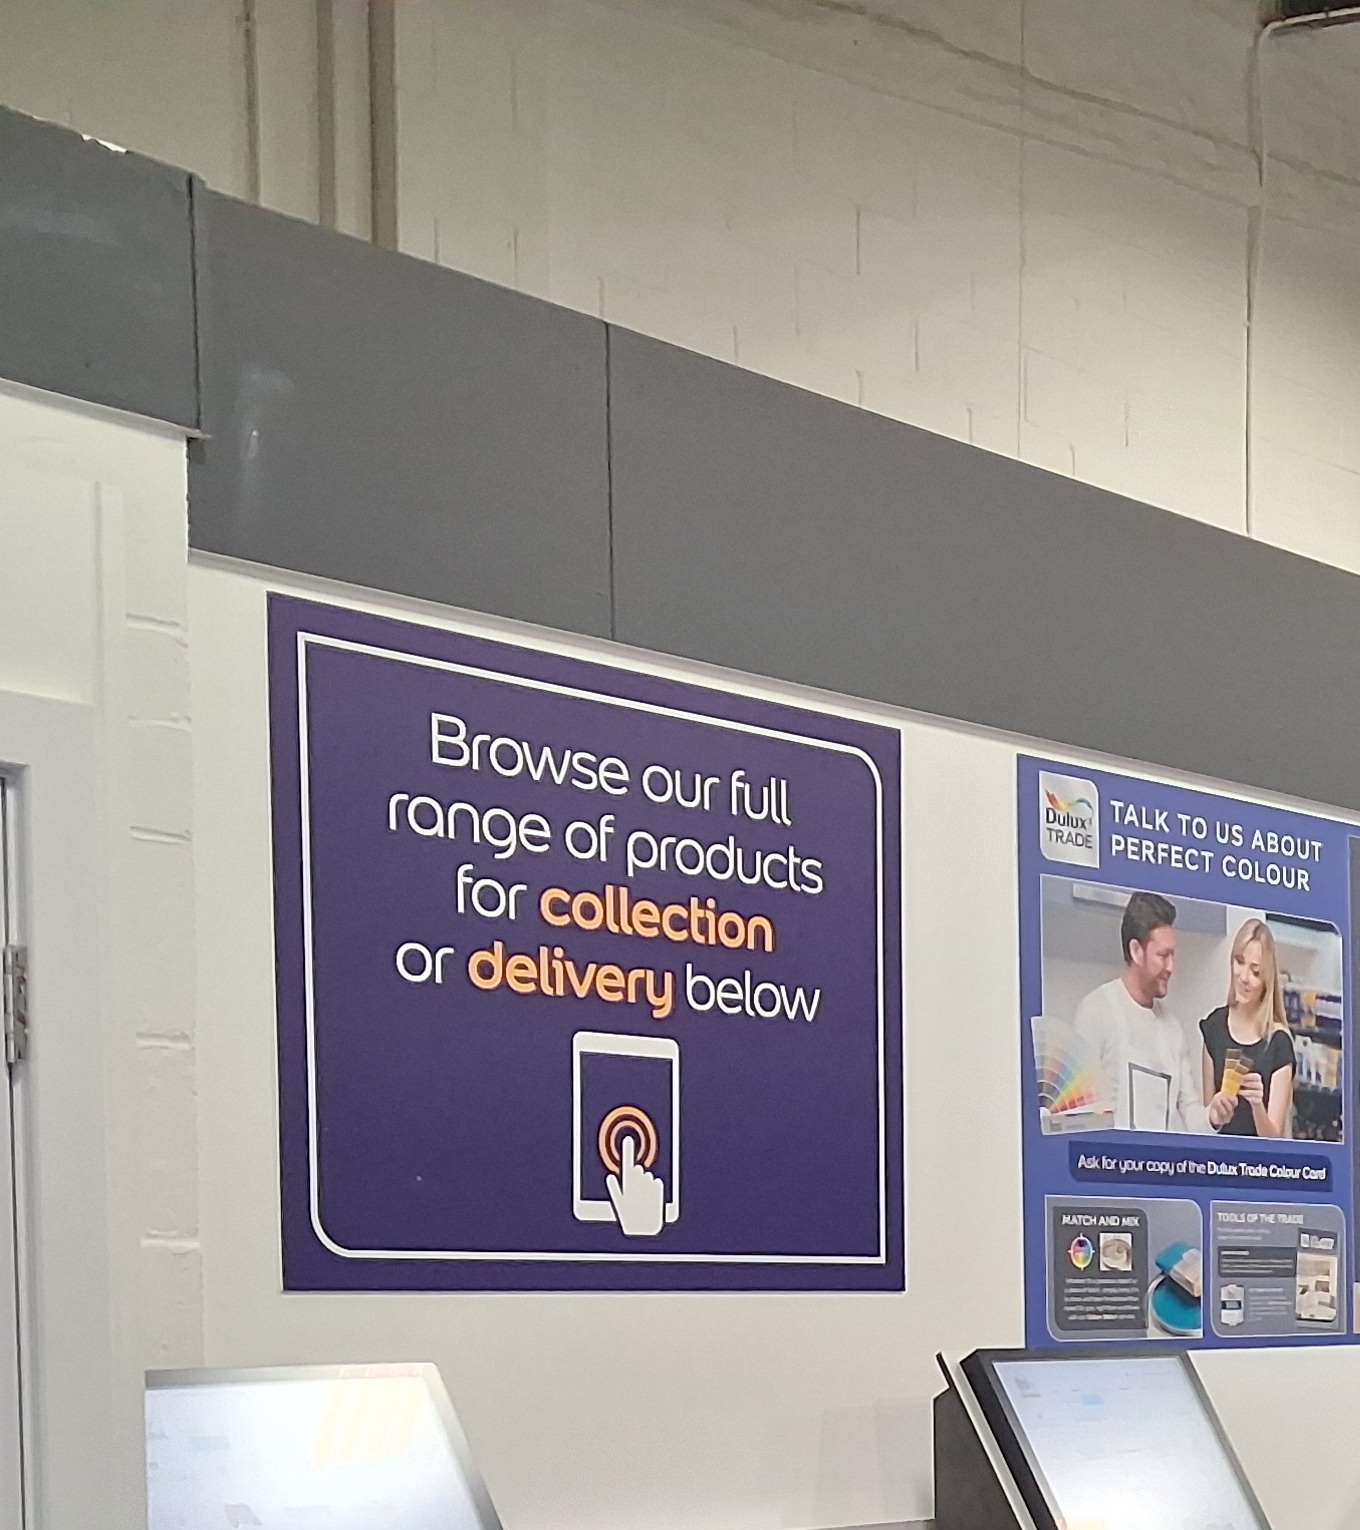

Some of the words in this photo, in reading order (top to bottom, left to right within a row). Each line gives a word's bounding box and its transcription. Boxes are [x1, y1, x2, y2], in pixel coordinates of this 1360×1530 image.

[430, 712, 631, 796] Browse
[641, 764, 720, 812] our
[729, 770, 792, 827] full
[388, 792, 552, 859] range
[564, 814, 615, 862] of
[626, 828, 824, 895] products
[1045, 807, 1087, 831] Dulux
[1045, 826, 1093, 849] TRADE
[1109, 799, 1170, 833] TALK
[1177, 812, 1208, 839] TO
[1215, 820, 1244, 848] US
[1251, 829, 1324, 862] ABOUT
[1111, 833, 1214, 873] PERFECT
[1222, 854, 1310, 892] COLOUR
[456, 863, 527, 920] for
[539, 884, 775, 952] collection
[395, 941, 454, 984] or
[467, 940, 674, 1019] delivery
[686, 963, 821, 1023] below
[1077, 1153, 1101, 1170] Ask
[1101, 1155, 1117, 1170] for
[1119, 1158, 1146, 1174] your
[1146, 1160, 1175, 1176] copy
[1176, 1159, 1188, 1173] of
[1188, 1159, 1206, 1174] the
[1207, 1160, 1238, 1176] Dulux
[1239, 1162, 1268, 1178] Trade
[1269, 1163, 1301, 1179] Colour
[1301, 1165, 1326, 1181] Card
[1061, 1212, 1098, 1228] MATCH
[1098, 1213, 1120, 1227] AND
[1121, 1214, 1141, 1228] MIX
[1216, 1211, 1245, 1225] TOOLS
[1247, 1212, 1259, 1225] OF
[1259, 1212, 1276, 1226] THE
